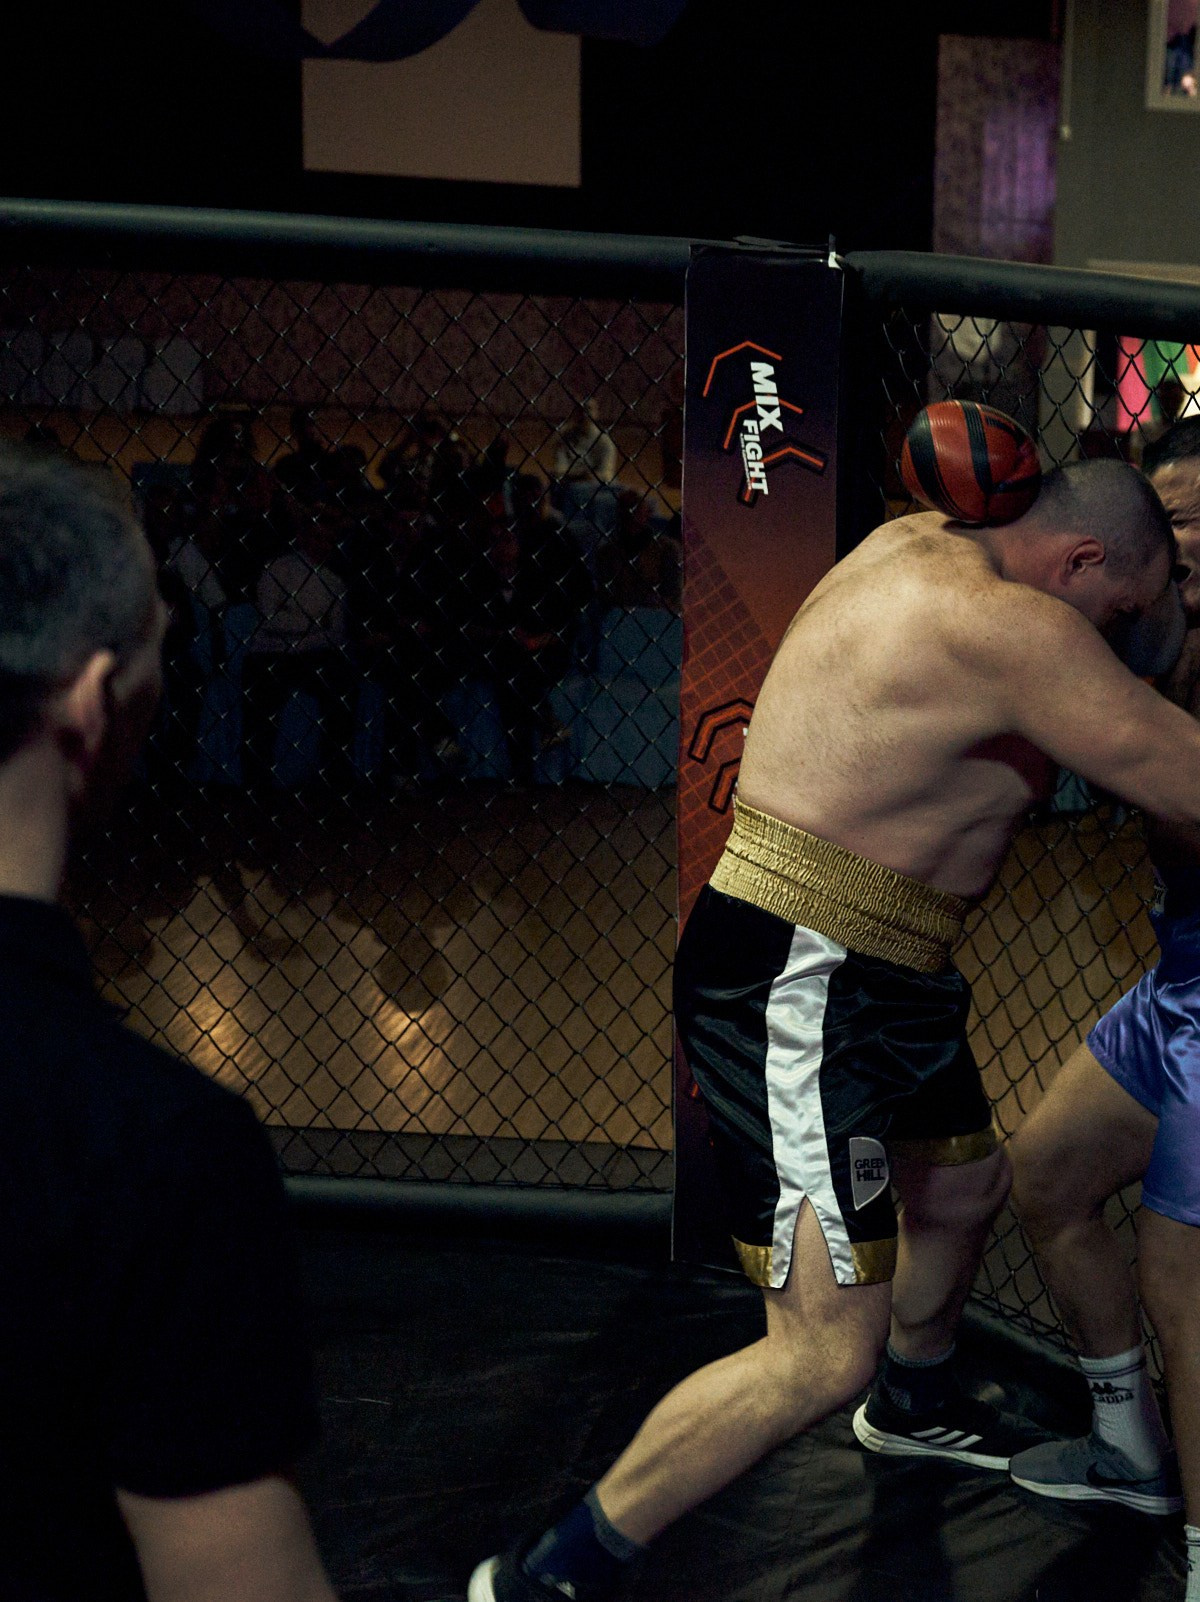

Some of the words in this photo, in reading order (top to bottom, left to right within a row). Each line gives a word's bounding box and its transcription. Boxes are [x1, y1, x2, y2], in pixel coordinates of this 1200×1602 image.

[750, 361, 784, 433] MIX
[742, 419, 769, 495] FIGHT
[857, 1169, 885, 1181] HILL
